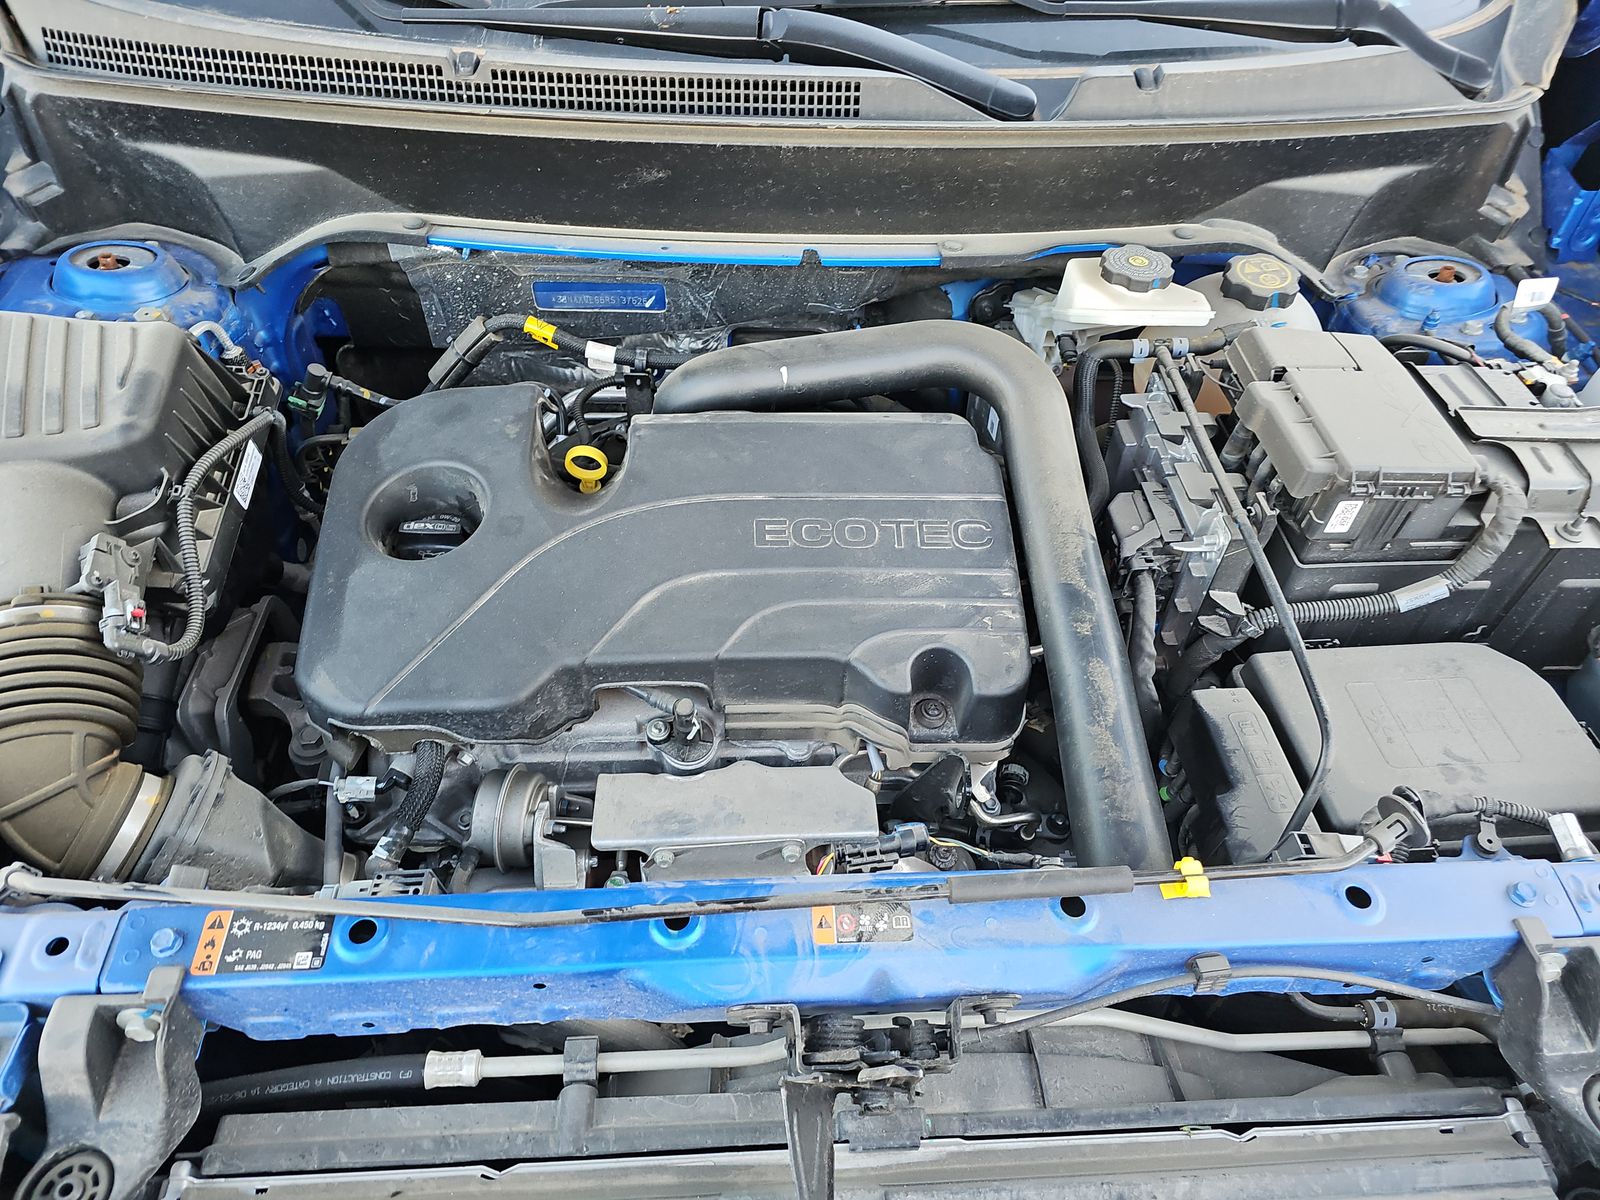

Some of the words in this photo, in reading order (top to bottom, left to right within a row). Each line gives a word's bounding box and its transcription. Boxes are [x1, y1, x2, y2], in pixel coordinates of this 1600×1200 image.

[753, 518, 993, 549] ECOTEC
[292, 920, 313, 930] 0.450
[314, 920, 326, 931] kg
[245, 949, 263, 960] PAG
[327, 1070, 392, 1086] CONSTRUCTION
[264, 1079, 310, 1095] CATEGORY
